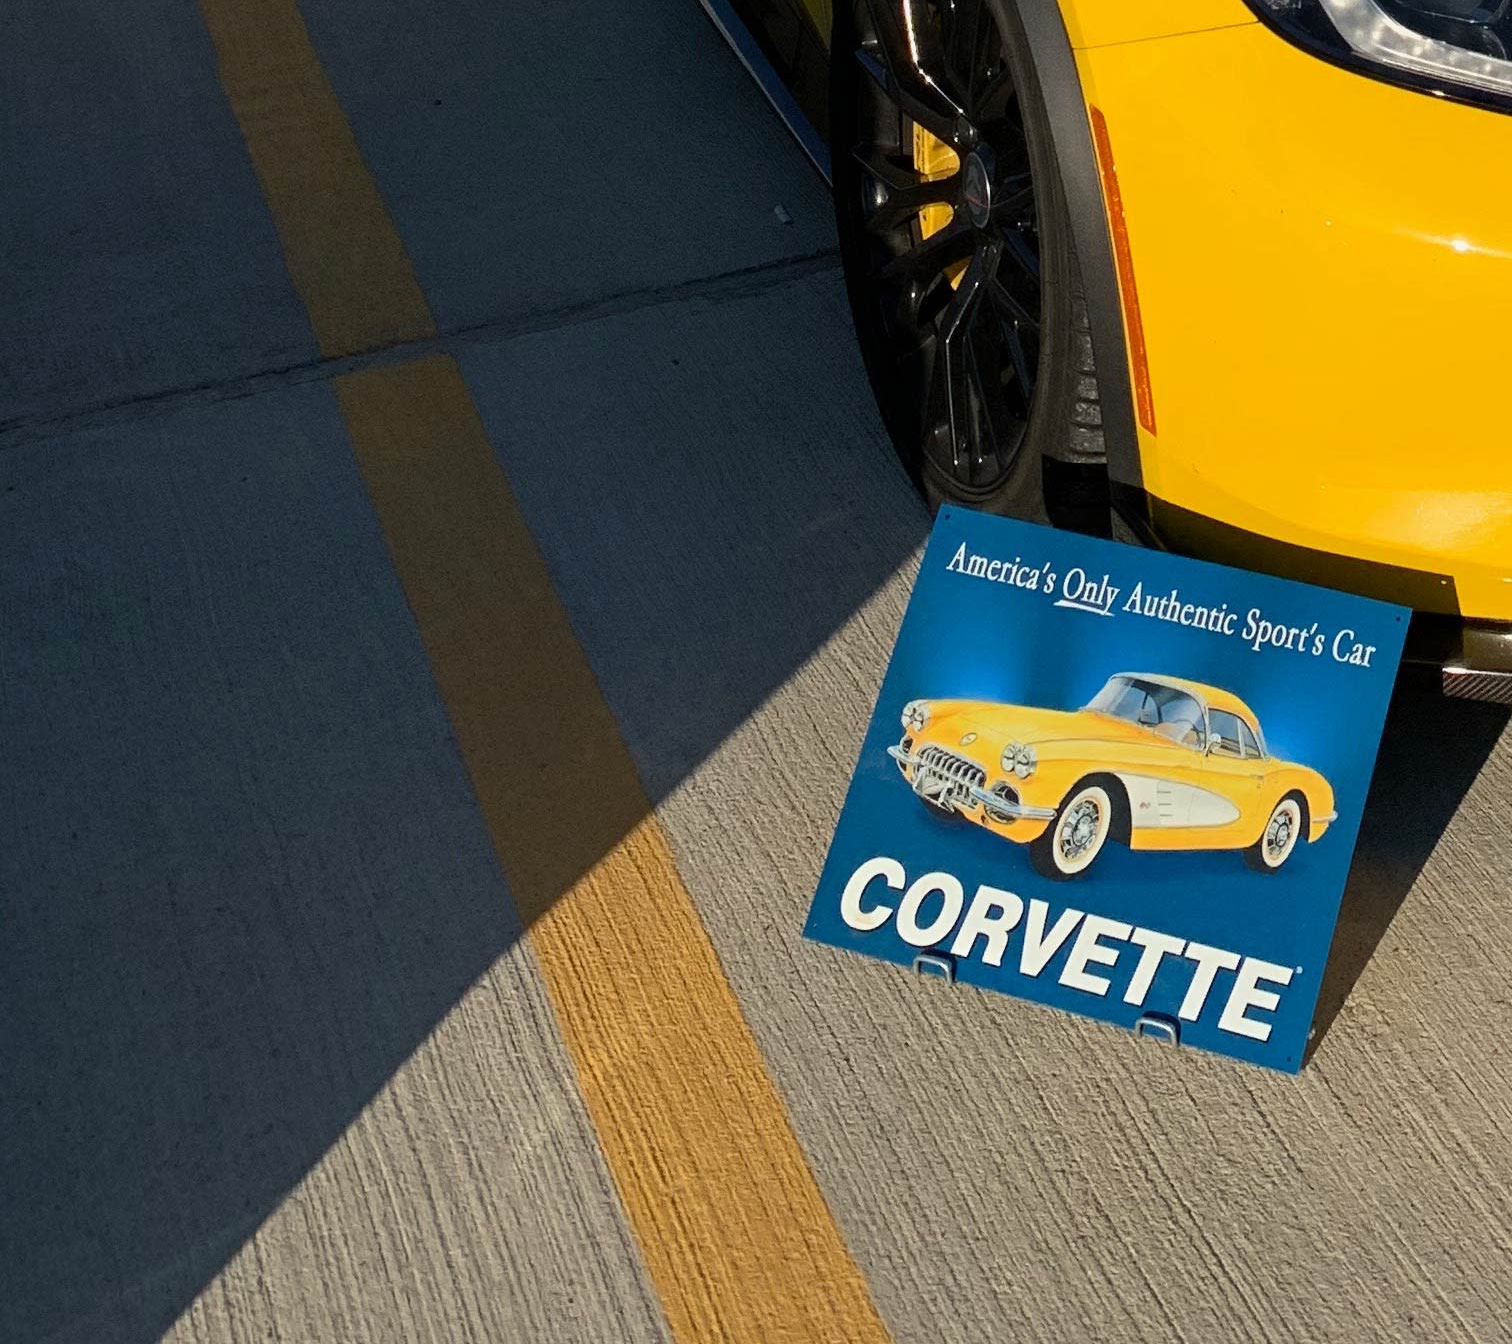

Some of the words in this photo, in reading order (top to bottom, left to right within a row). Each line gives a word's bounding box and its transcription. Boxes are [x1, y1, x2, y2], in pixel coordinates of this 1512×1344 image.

[946, 541, 1057, 594] America's
[1062, 567, 1121, 614] Only
[1122, 581, 1238, 636] Authentic
[1242, 608, 1325, 656] Sport's
[1332, 629, 1376, 667] Car
[840, 858, 1295, 1042] CORVETTE
